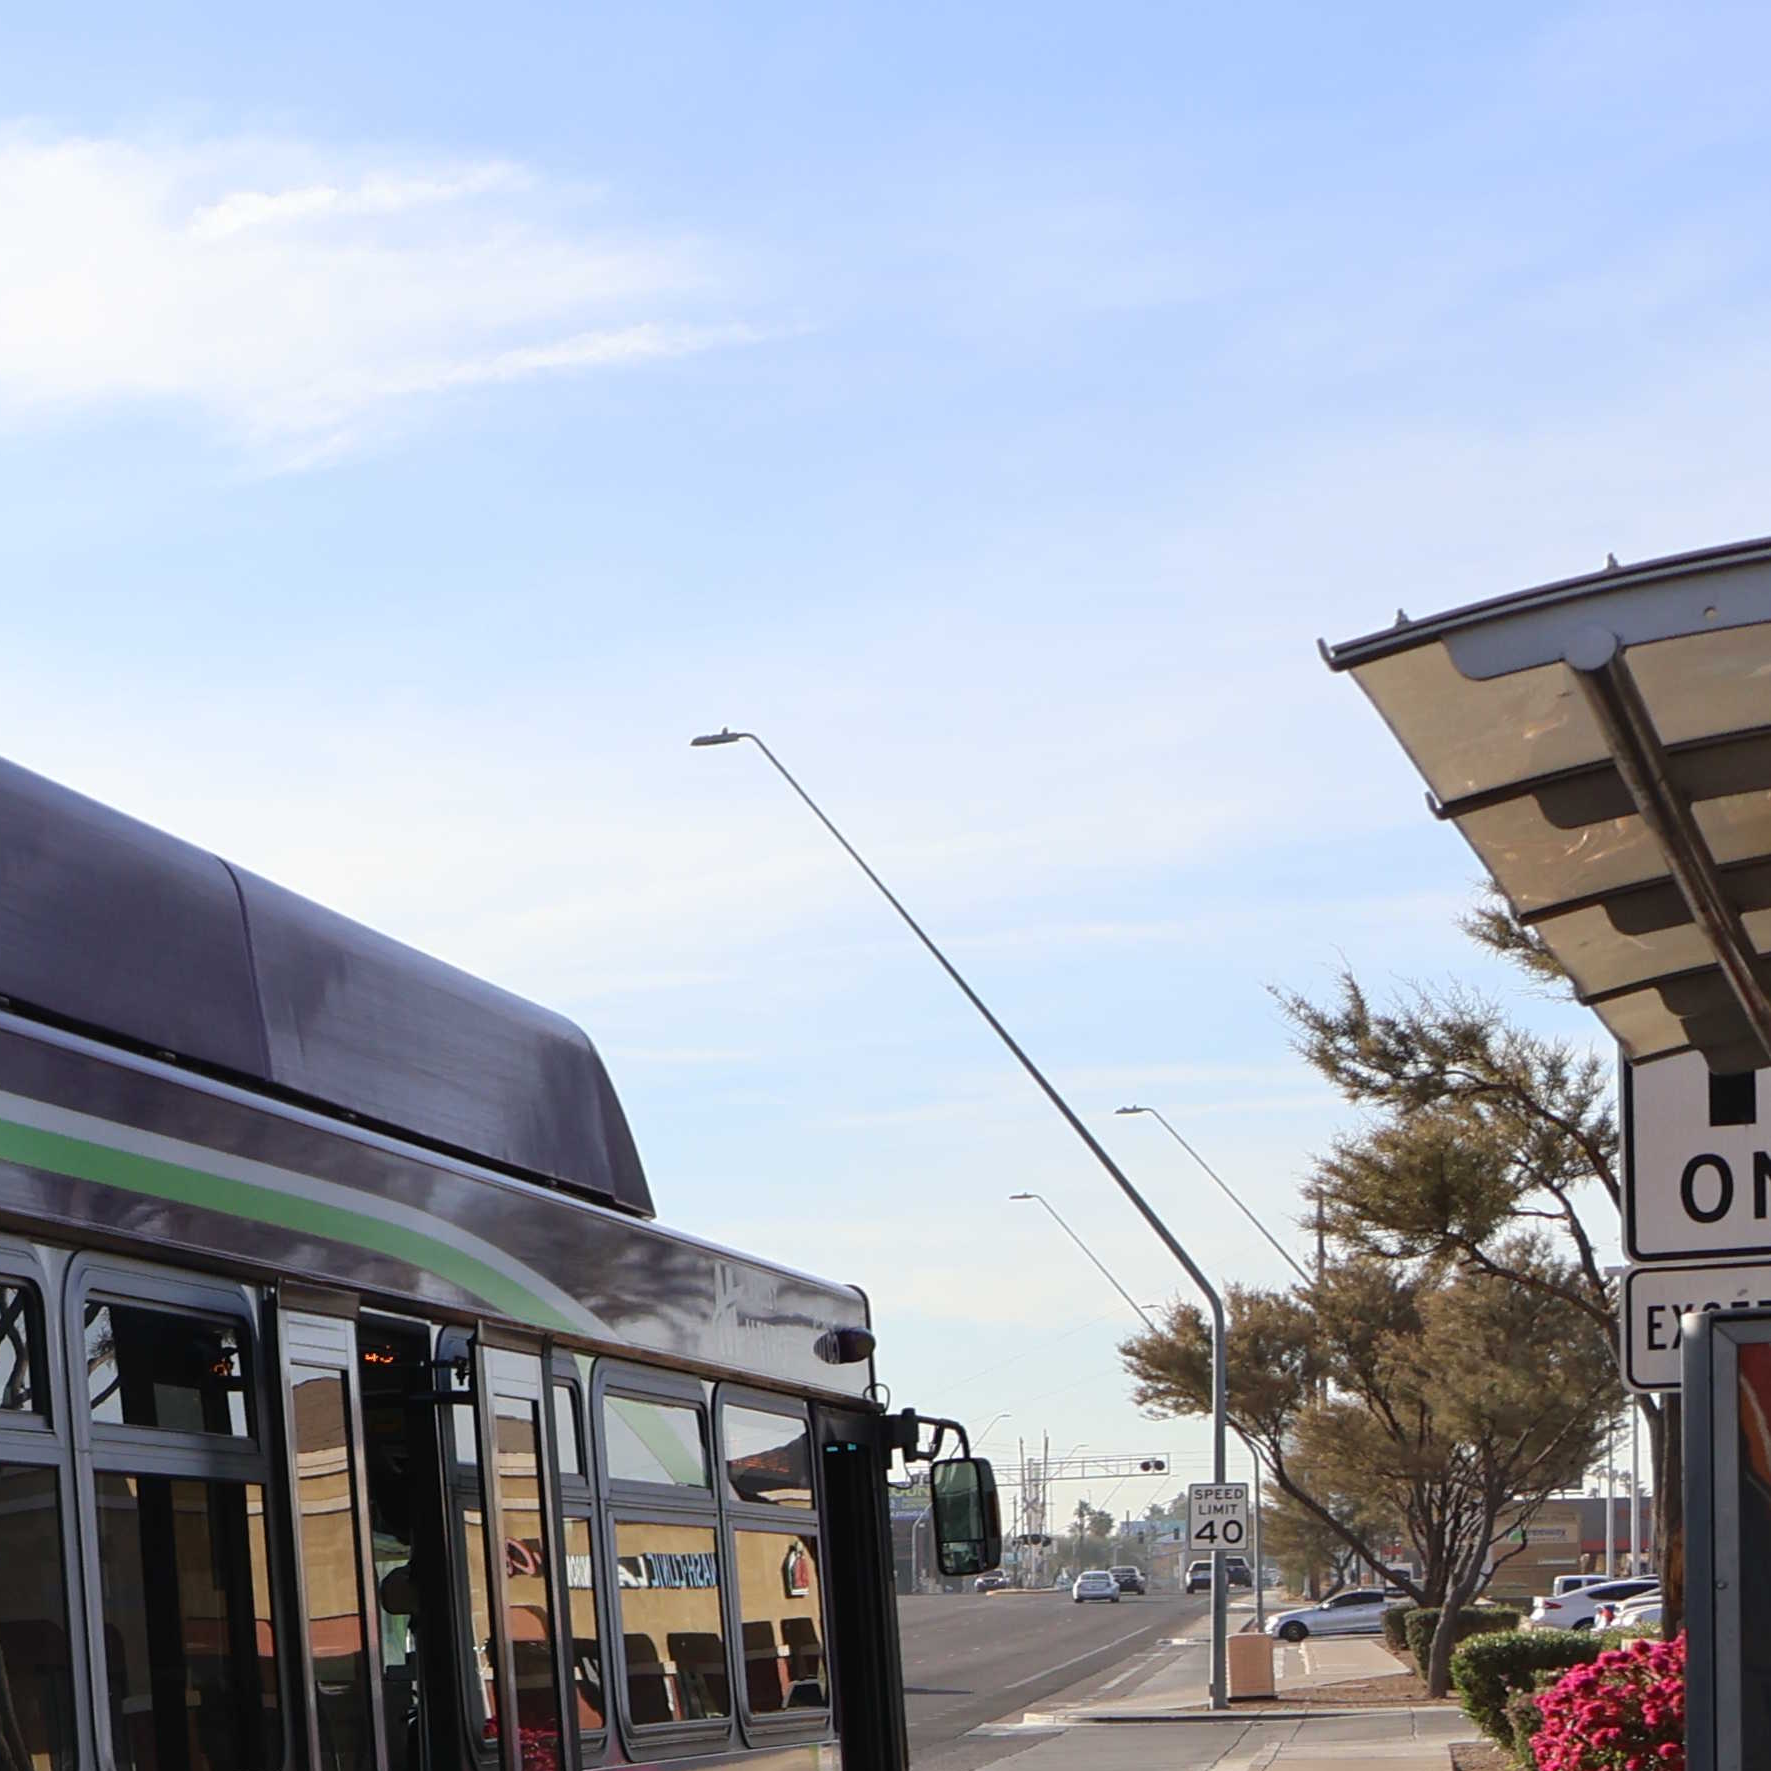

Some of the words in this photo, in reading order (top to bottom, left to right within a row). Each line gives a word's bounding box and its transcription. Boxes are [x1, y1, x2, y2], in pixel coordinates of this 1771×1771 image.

[1194, 1489, 1244, 1500] SPEED
[1198, 1503, 1238, 1516] LIMIT
[1194, 1519, 1244, 1545] 40
